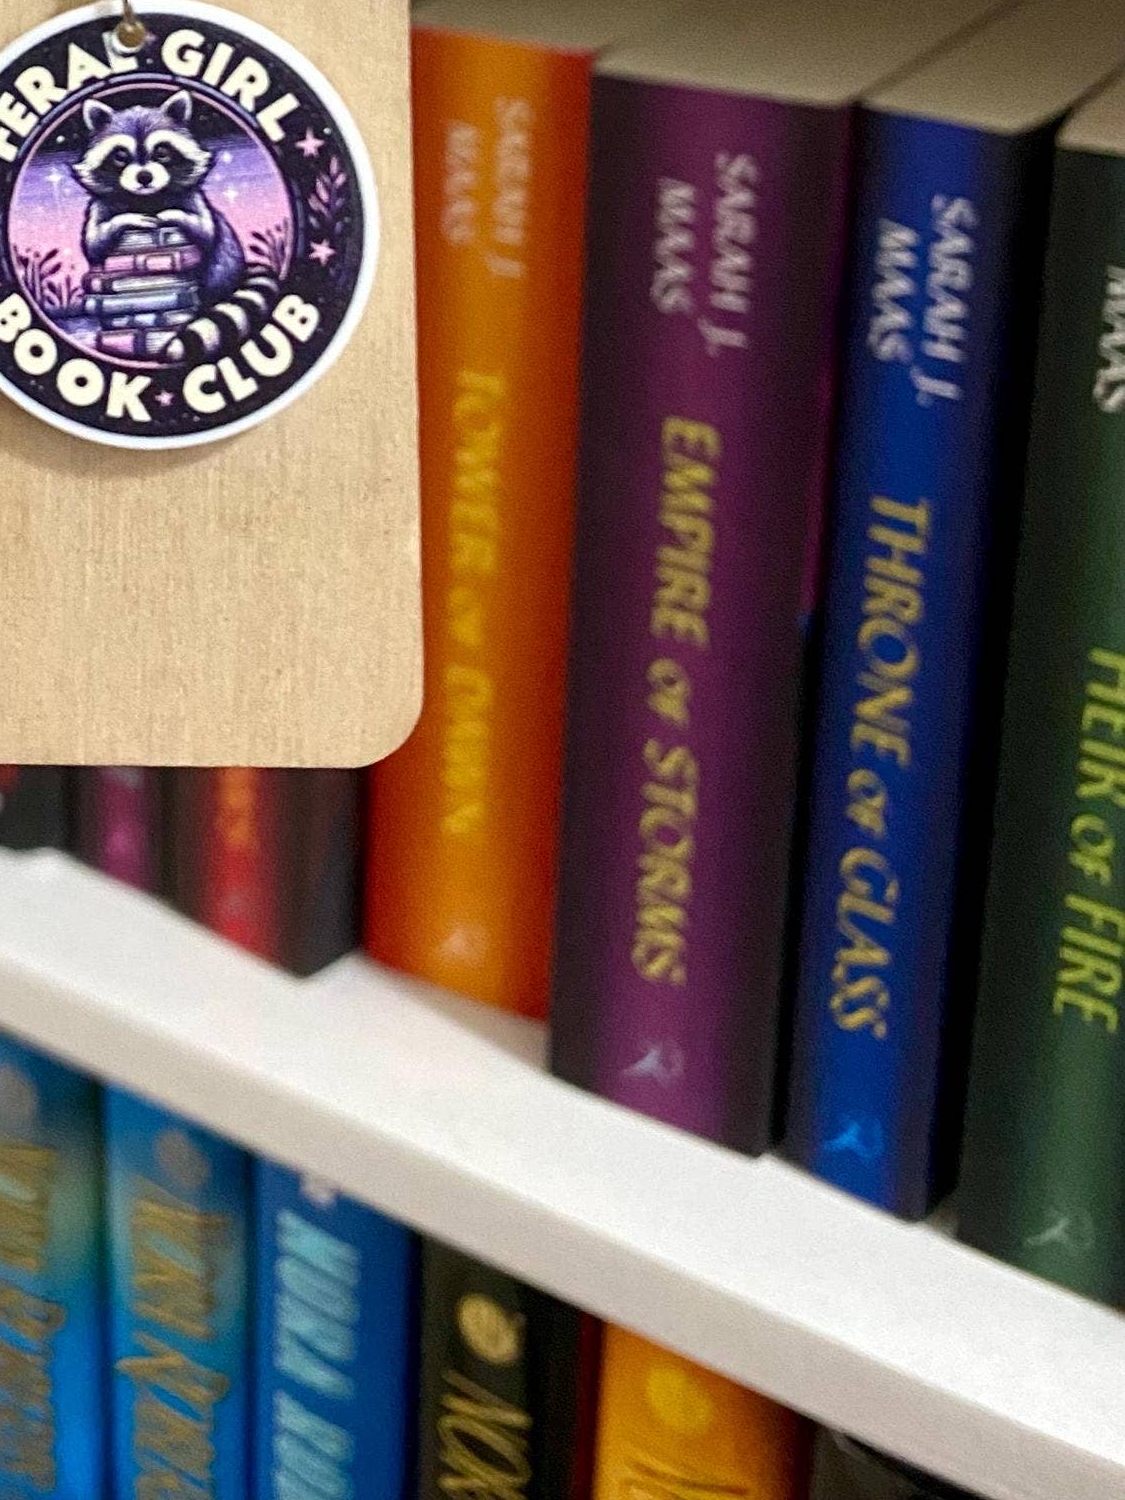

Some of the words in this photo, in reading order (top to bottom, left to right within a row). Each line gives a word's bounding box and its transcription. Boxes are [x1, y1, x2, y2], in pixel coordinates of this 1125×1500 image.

[160, 28, 305, 143] GIRL
[649, 177, 697, 315] MAAS
[711, 151, 761, 315] SARAH
[865, 217, 921, 366] MAAS
[923, 195, 978, 363] SARAH
[182, 298, 323, 417] CLUB
[649, 415, 722, 649] EMPIRE
[848, 495, 932, 769] THRONE
[1073, 645, 1125, 808] HEIR
[630, 737, 701, 986] STORMS
[1068, 812, 1116, 886] OF
[828, 846, 901, 1040] GLASS
[1051, 893, 1125, 1034] FIRE
